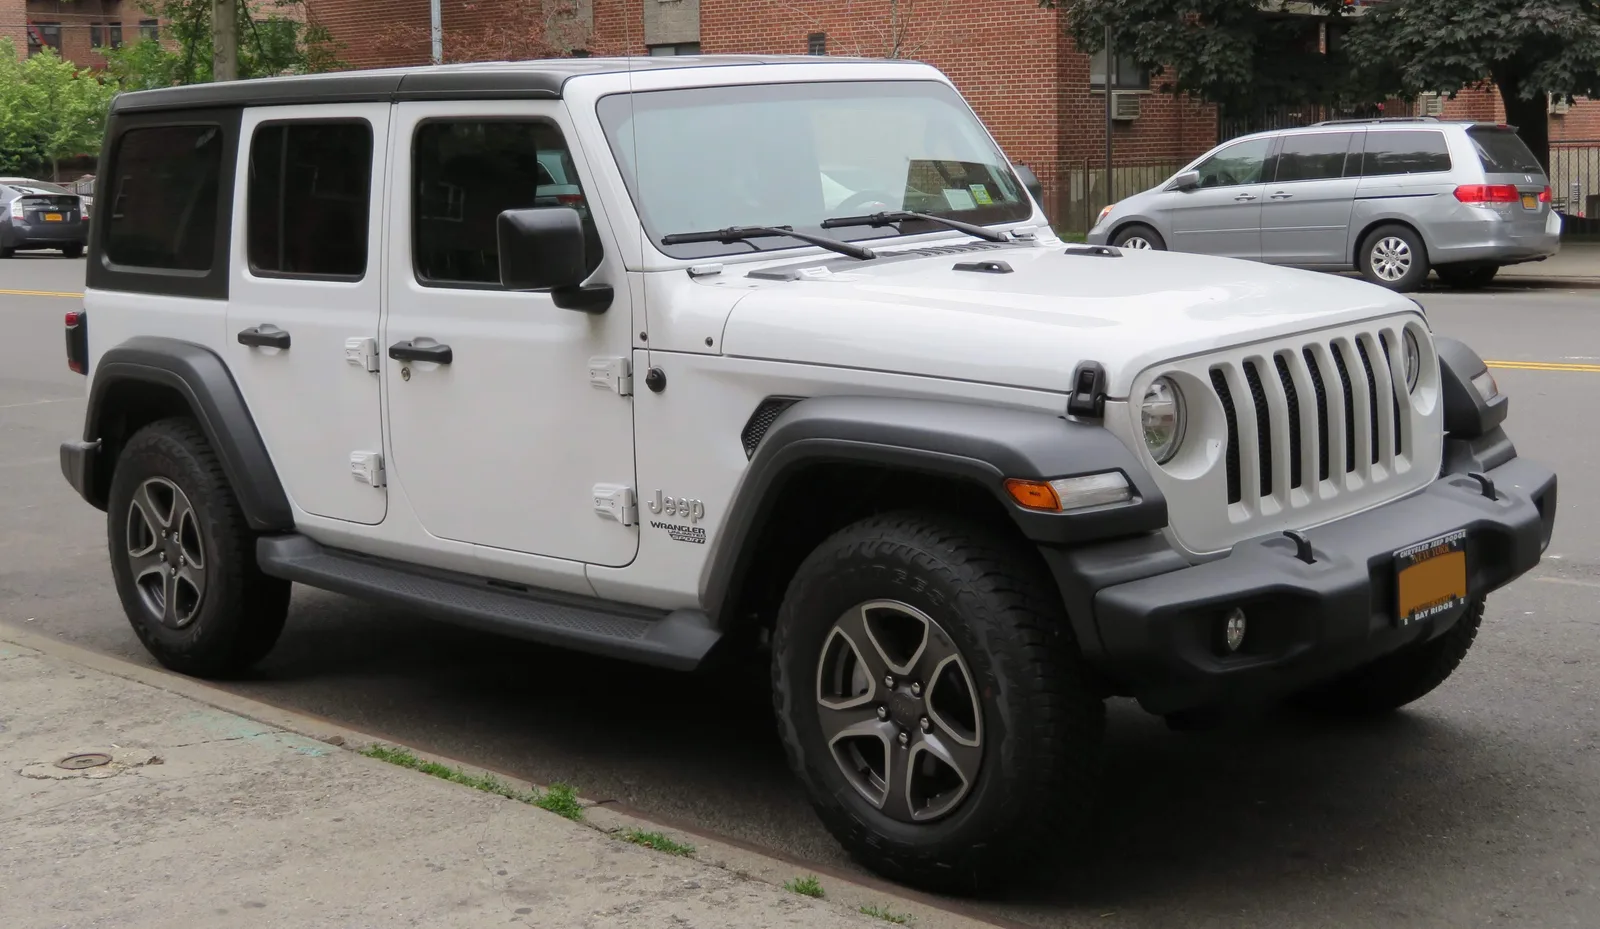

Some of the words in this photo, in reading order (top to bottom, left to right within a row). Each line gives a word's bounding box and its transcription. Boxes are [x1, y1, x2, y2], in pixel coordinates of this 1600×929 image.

[647, 488, 705, 524] Jeep
[650, 520, 706, 535] WRANGLER
[1400, 543, 1429, 558] CHRYSLER
[1430, 538, 1444, 548] JEEP
[1445, 531, 1466, 543] DODGE
[1414, 609, 1429, 621] BAY
